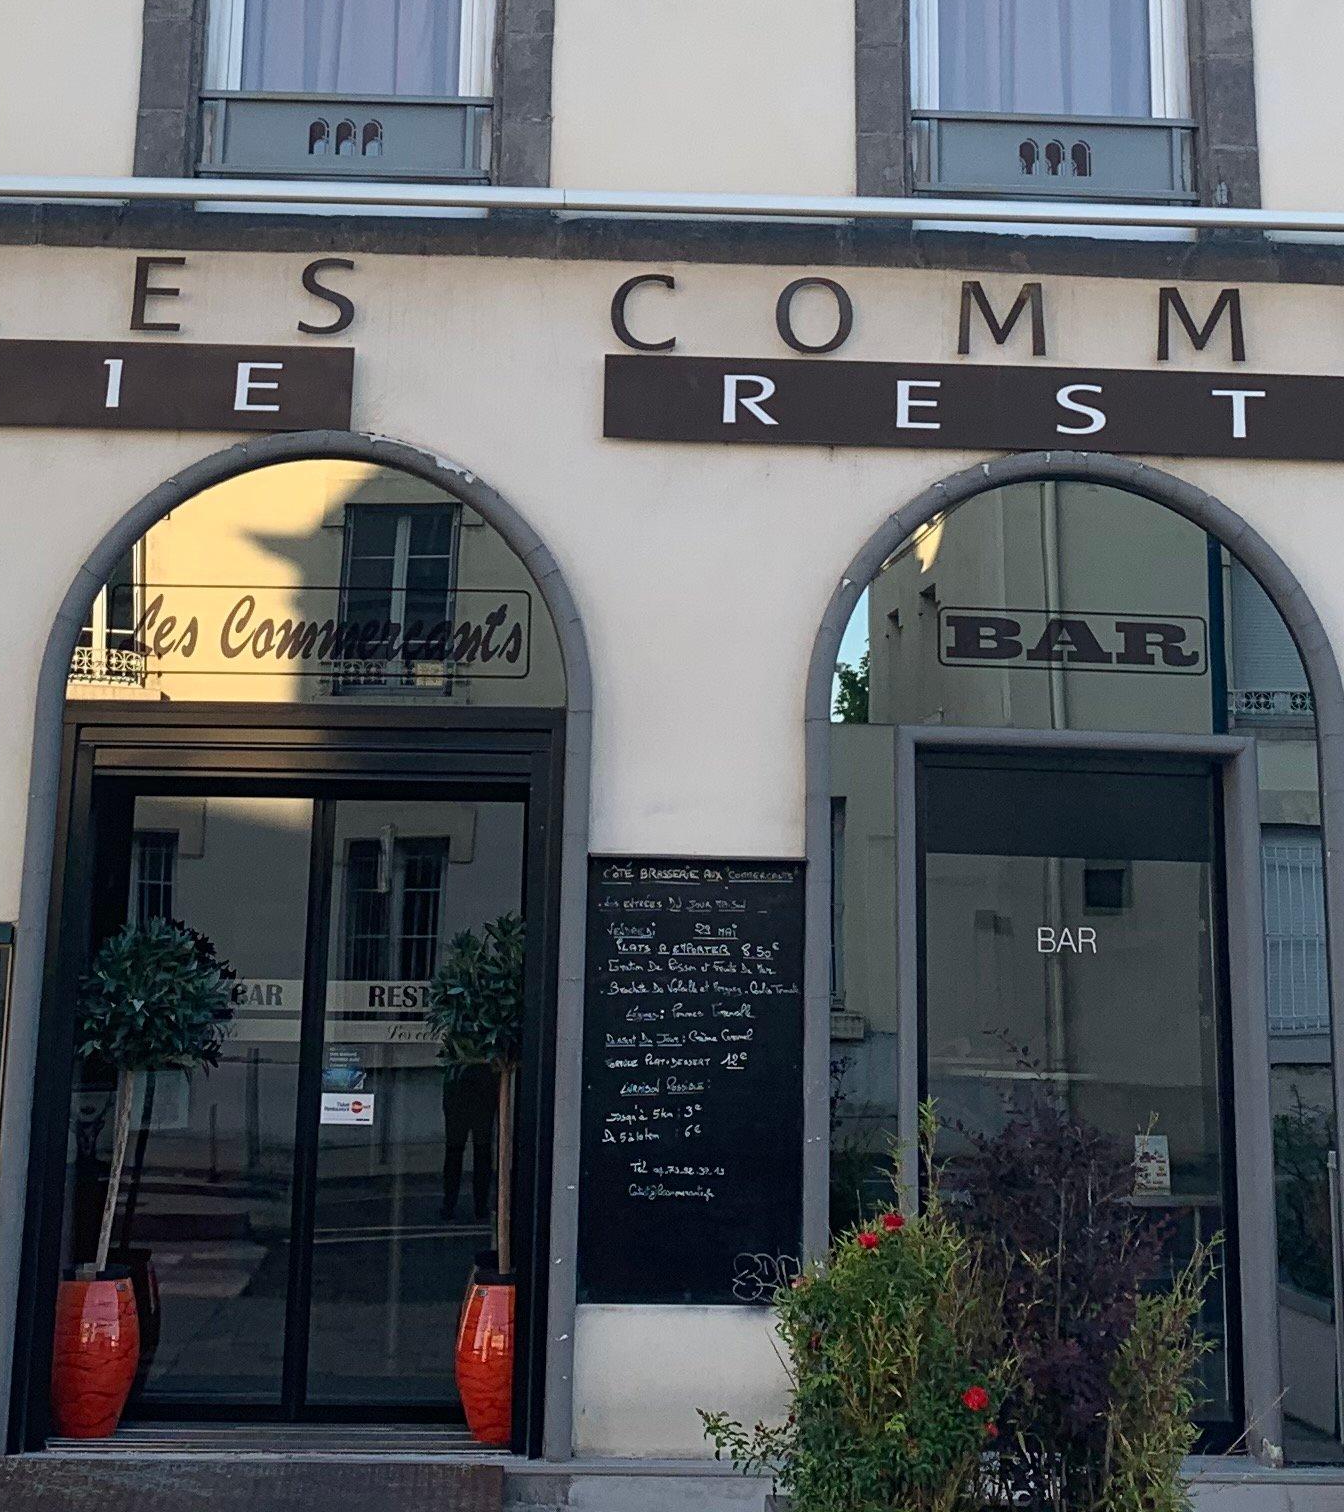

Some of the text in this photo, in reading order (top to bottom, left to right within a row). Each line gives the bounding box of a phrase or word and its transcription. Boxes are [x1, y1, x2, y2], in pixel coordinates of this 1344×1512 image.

[119, 593, 198, 659] Les
[944, 614, 1200, 668] BAR
[1036, 927, 1097, 954] BAR
